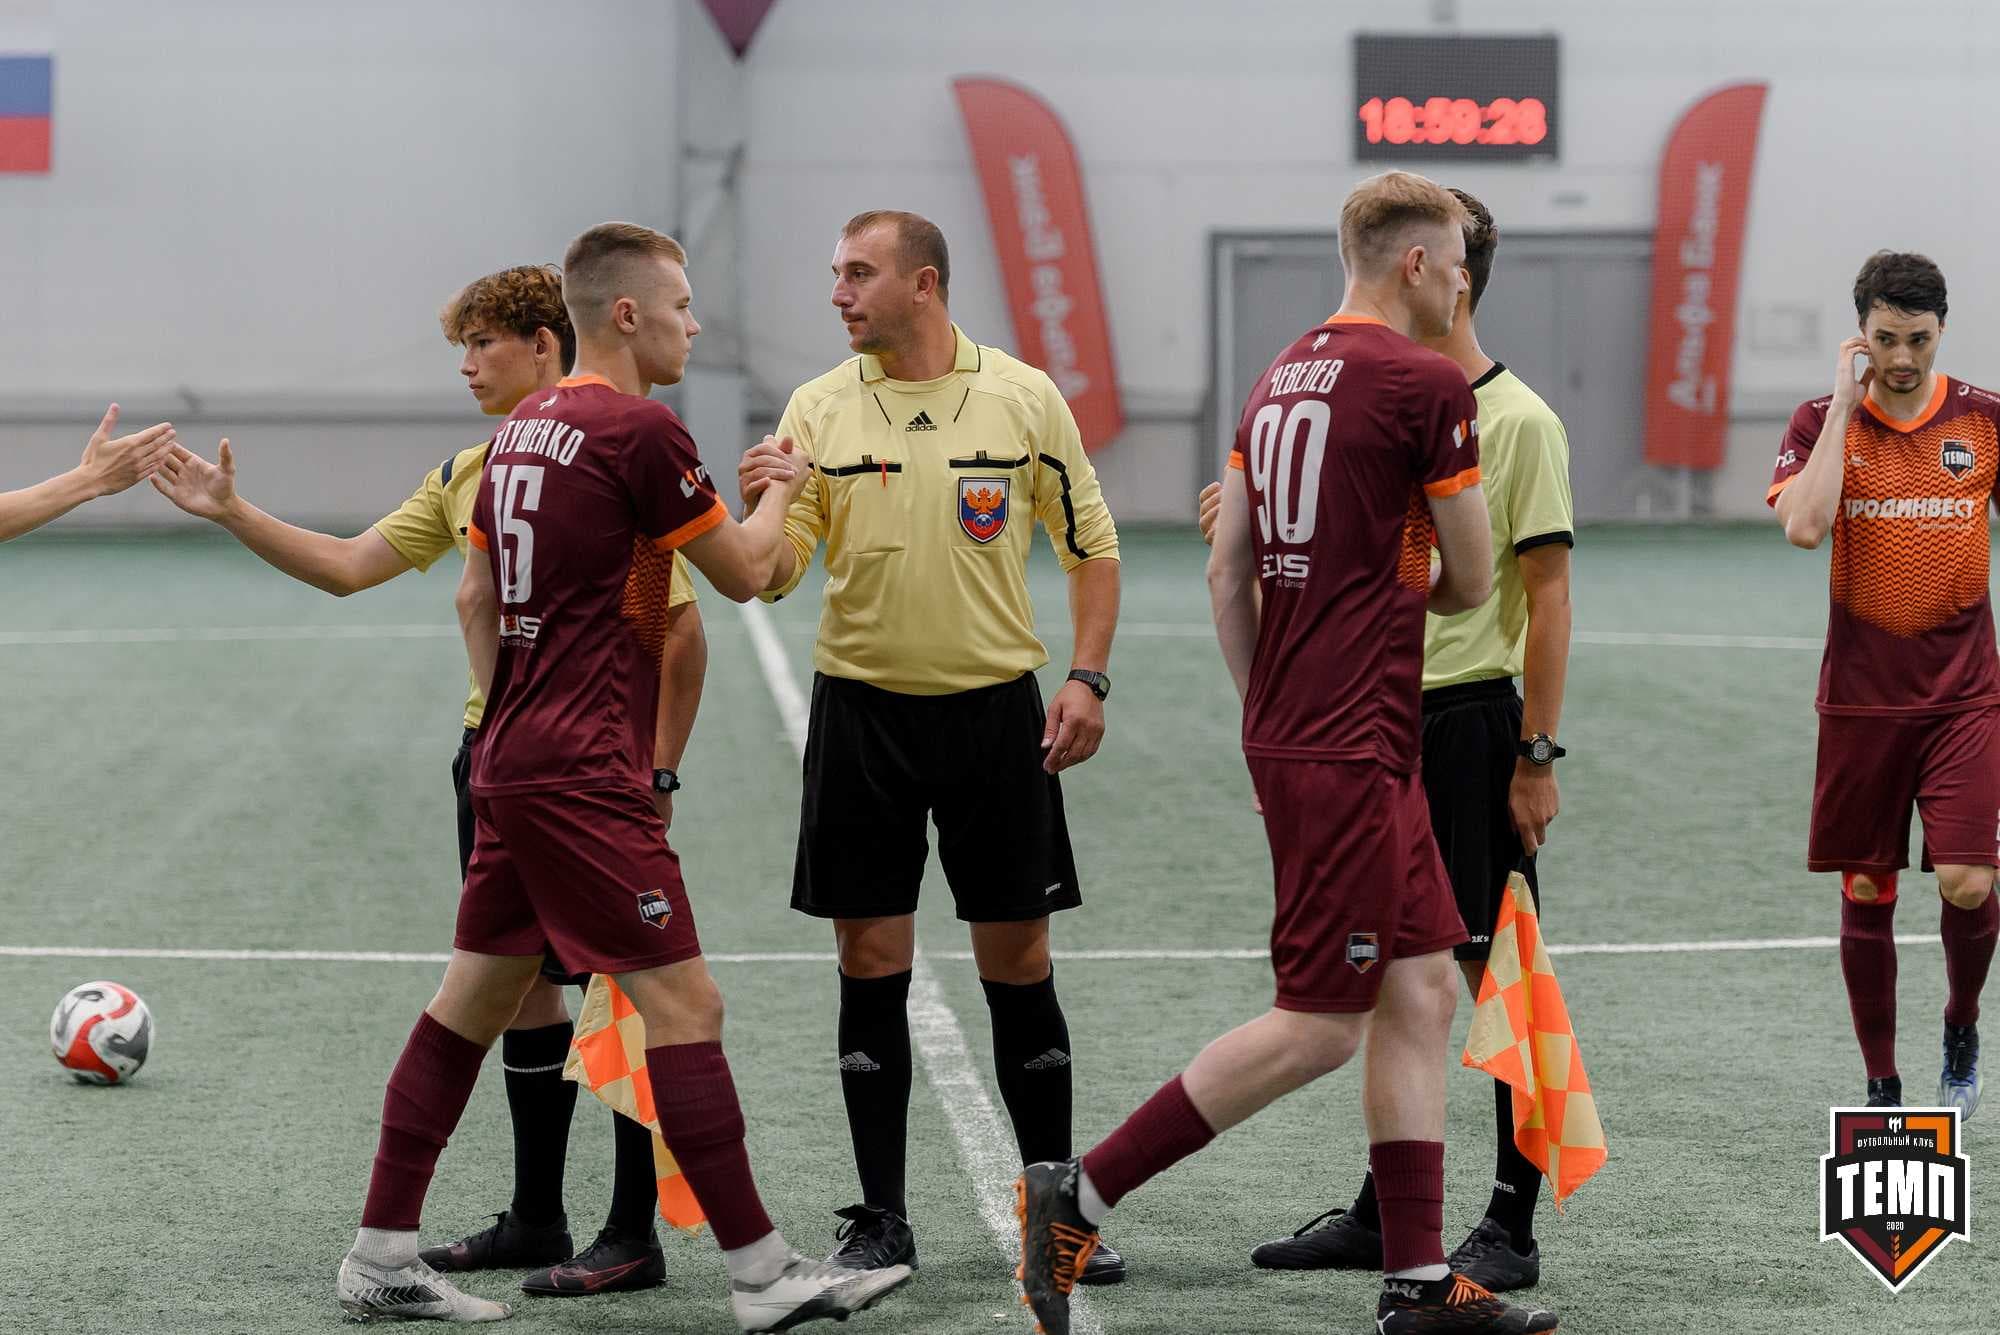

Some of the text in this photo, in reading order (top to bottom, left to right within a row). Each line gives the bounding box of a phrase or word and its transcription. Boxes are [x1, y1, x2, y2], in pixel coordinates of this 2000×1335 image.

[904, 424, 938, 433] adidas
[1943, 450, 1972, 467] ТЕМП
[1250, 399, 1331, 544] 90
[490, 464, 545, 603] 15
